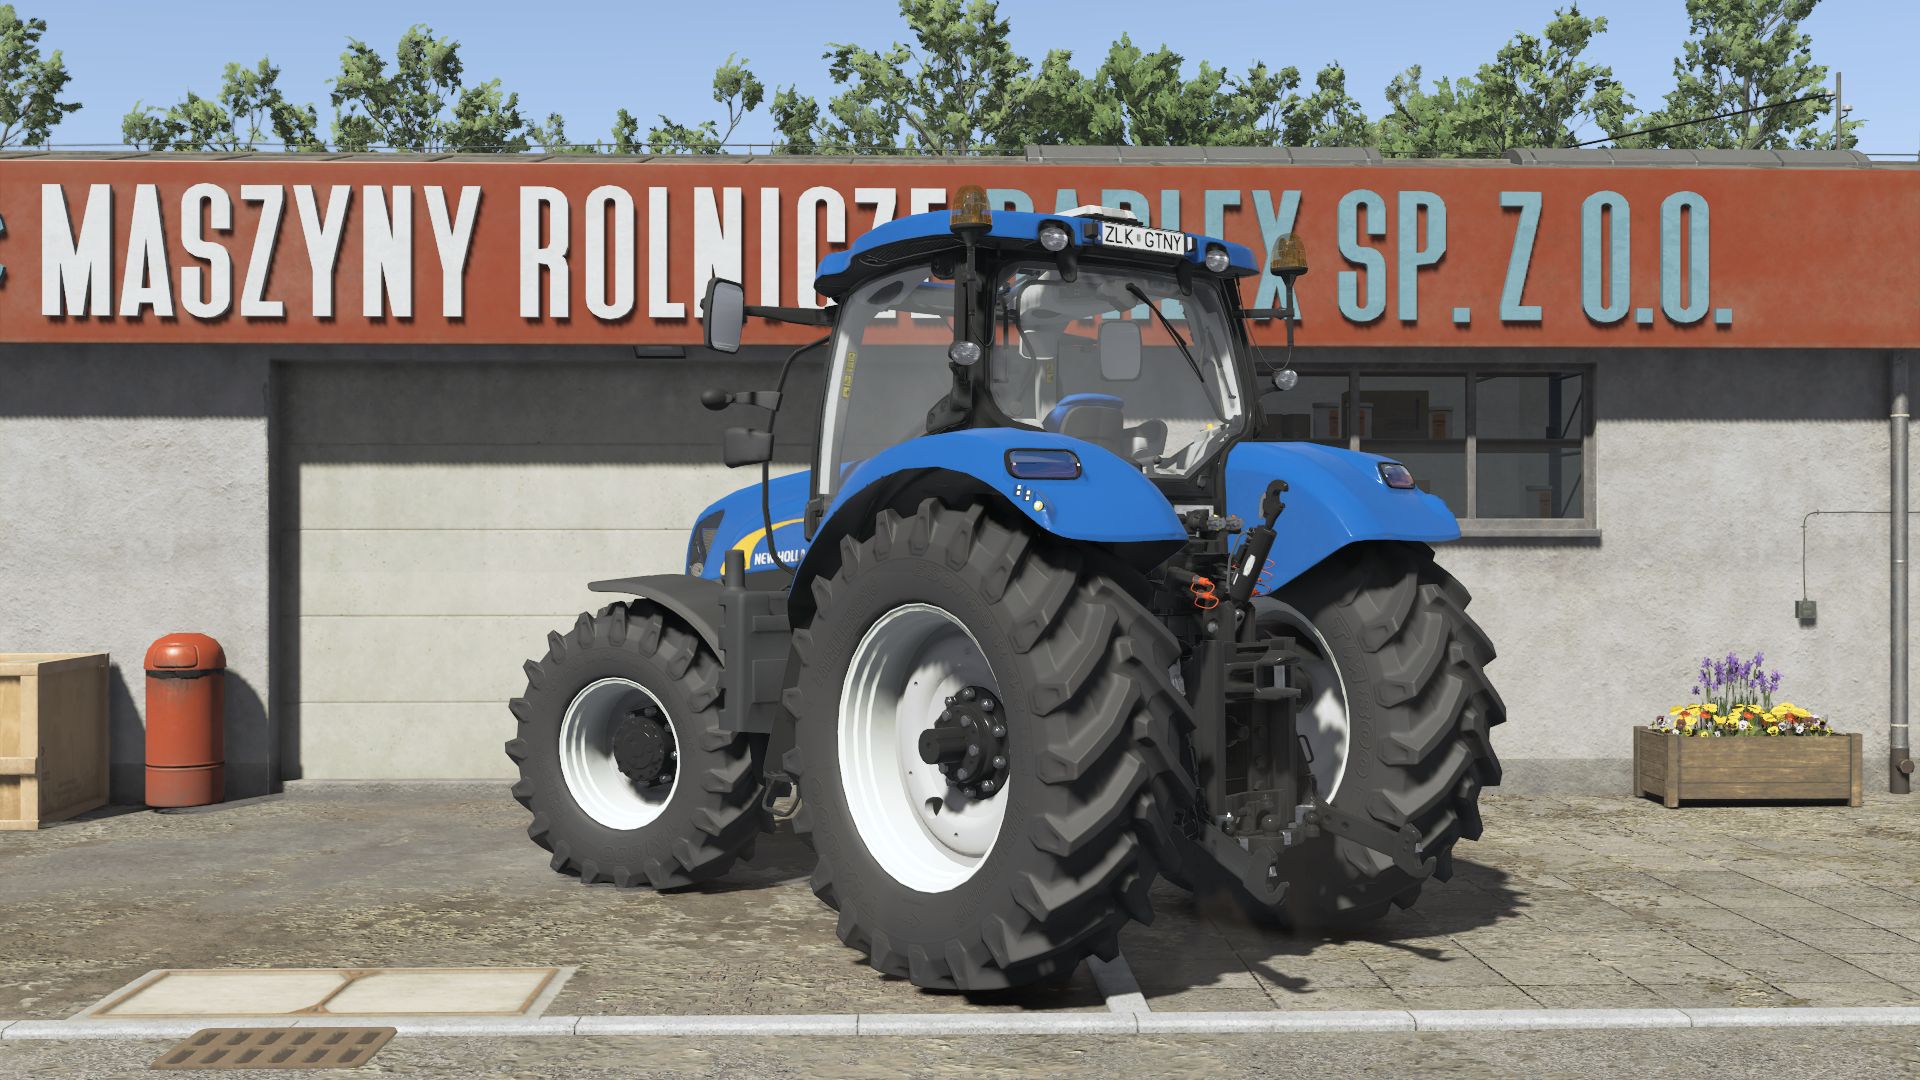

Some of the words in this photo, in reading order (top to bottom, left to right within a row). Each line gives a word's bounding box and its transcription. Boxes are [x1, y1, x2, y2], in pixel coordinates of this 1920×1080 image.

[42, 183, 481, 318] MASZYNY
[520, 185, 946, 320] ROLNIC
[1105, 226, 1133, 245] ZLK
[1144, 231, 1181, 251] GTNY
[1338, 189, 1470, 323] SP.
[1500, 191, 1542, 321] Z
[1581, 190, 1732, 324] O.O.
